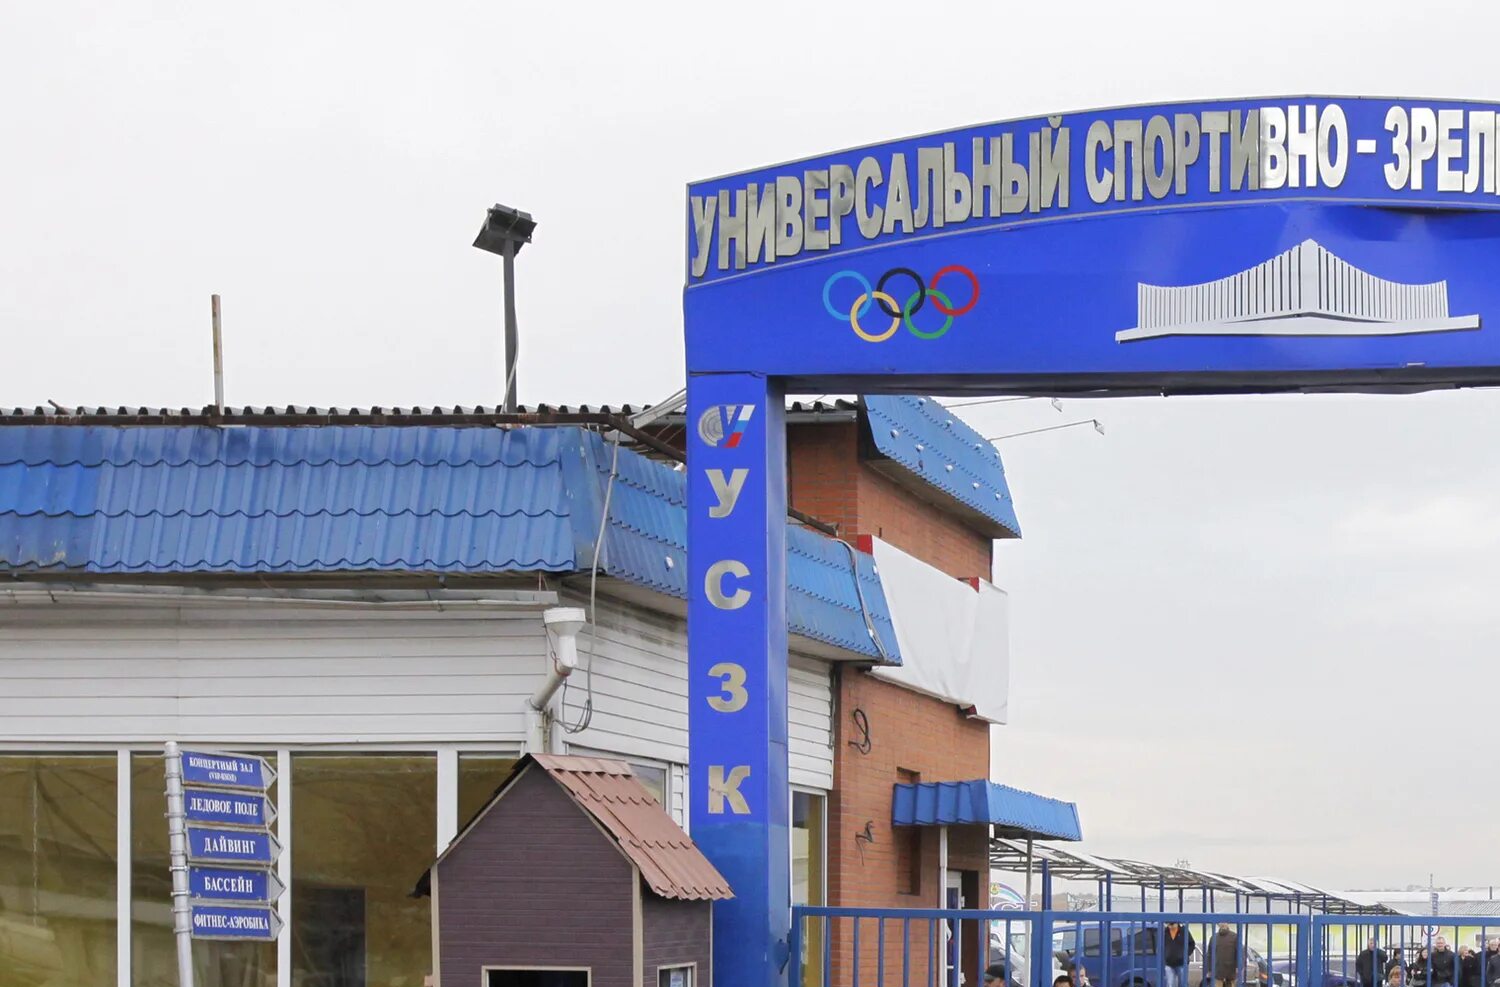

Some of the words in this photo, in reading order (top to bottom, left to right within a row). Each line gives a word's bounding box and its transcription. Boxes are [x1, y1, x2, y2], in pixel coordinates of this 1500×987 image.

[690, 115, 1071, 277] УНИВЕРСАЛЬНЫЙ
[189, 756, 238, 773] КОНЦЕРТНЫЙ
[240, 762, 254, 773] ЗАЛ
[190, 797, 232, 814] ЛЕДОВОЕ
[234, 802, 259, 816] ПОЛЕ
[203, 835, 256, 854] ДАЙВИНГ
[204, 875, 253, 893] БАССЕЙН
[193, 913, 269, 930] ФИТНЕС-АЭРОБИКА
